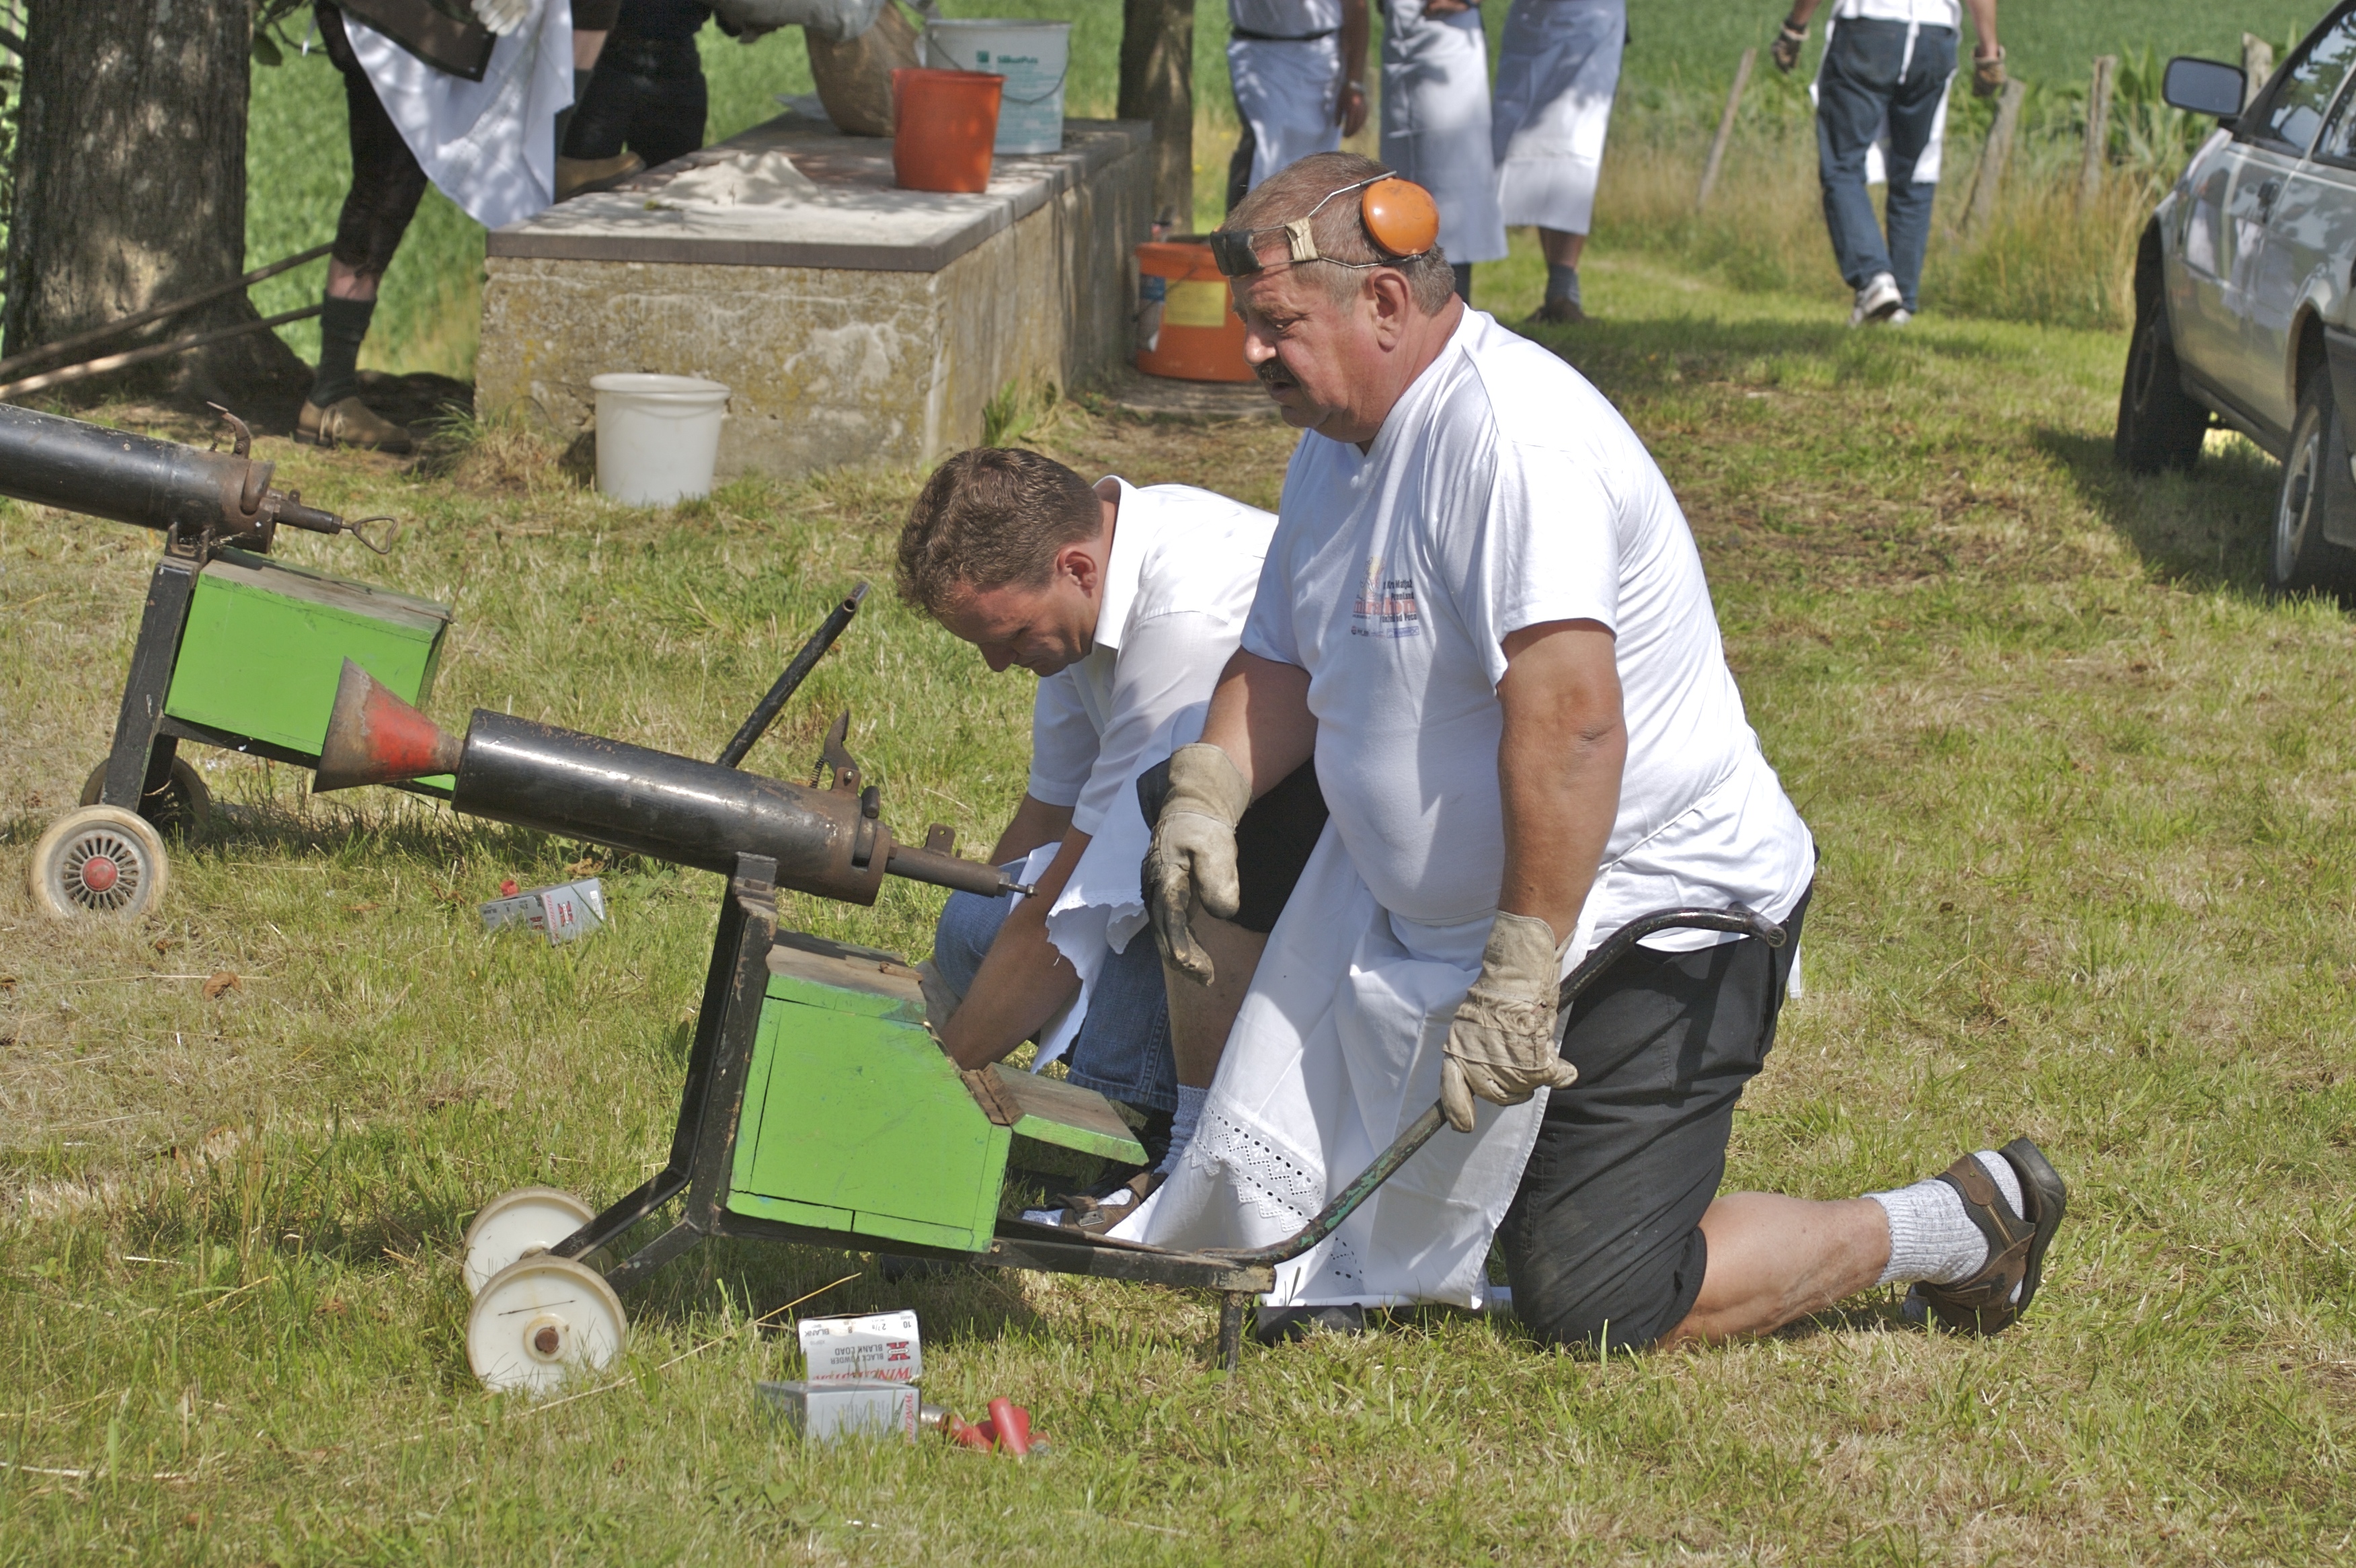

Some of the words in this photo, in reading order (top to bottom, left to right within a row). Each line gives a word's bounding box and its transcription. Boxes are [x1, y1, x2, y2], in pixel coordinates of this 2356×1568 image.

[903, 1321, 912, 1329] 10
[804, 1328, 830, 1337] BLANK
[834, 1347, 856, 1356] LOAD
[857, 1344, 883, 1354] BLANK
[830, 1354, 860, 1364] POWDER
[862, 1352, 884, 1361] BLACK
